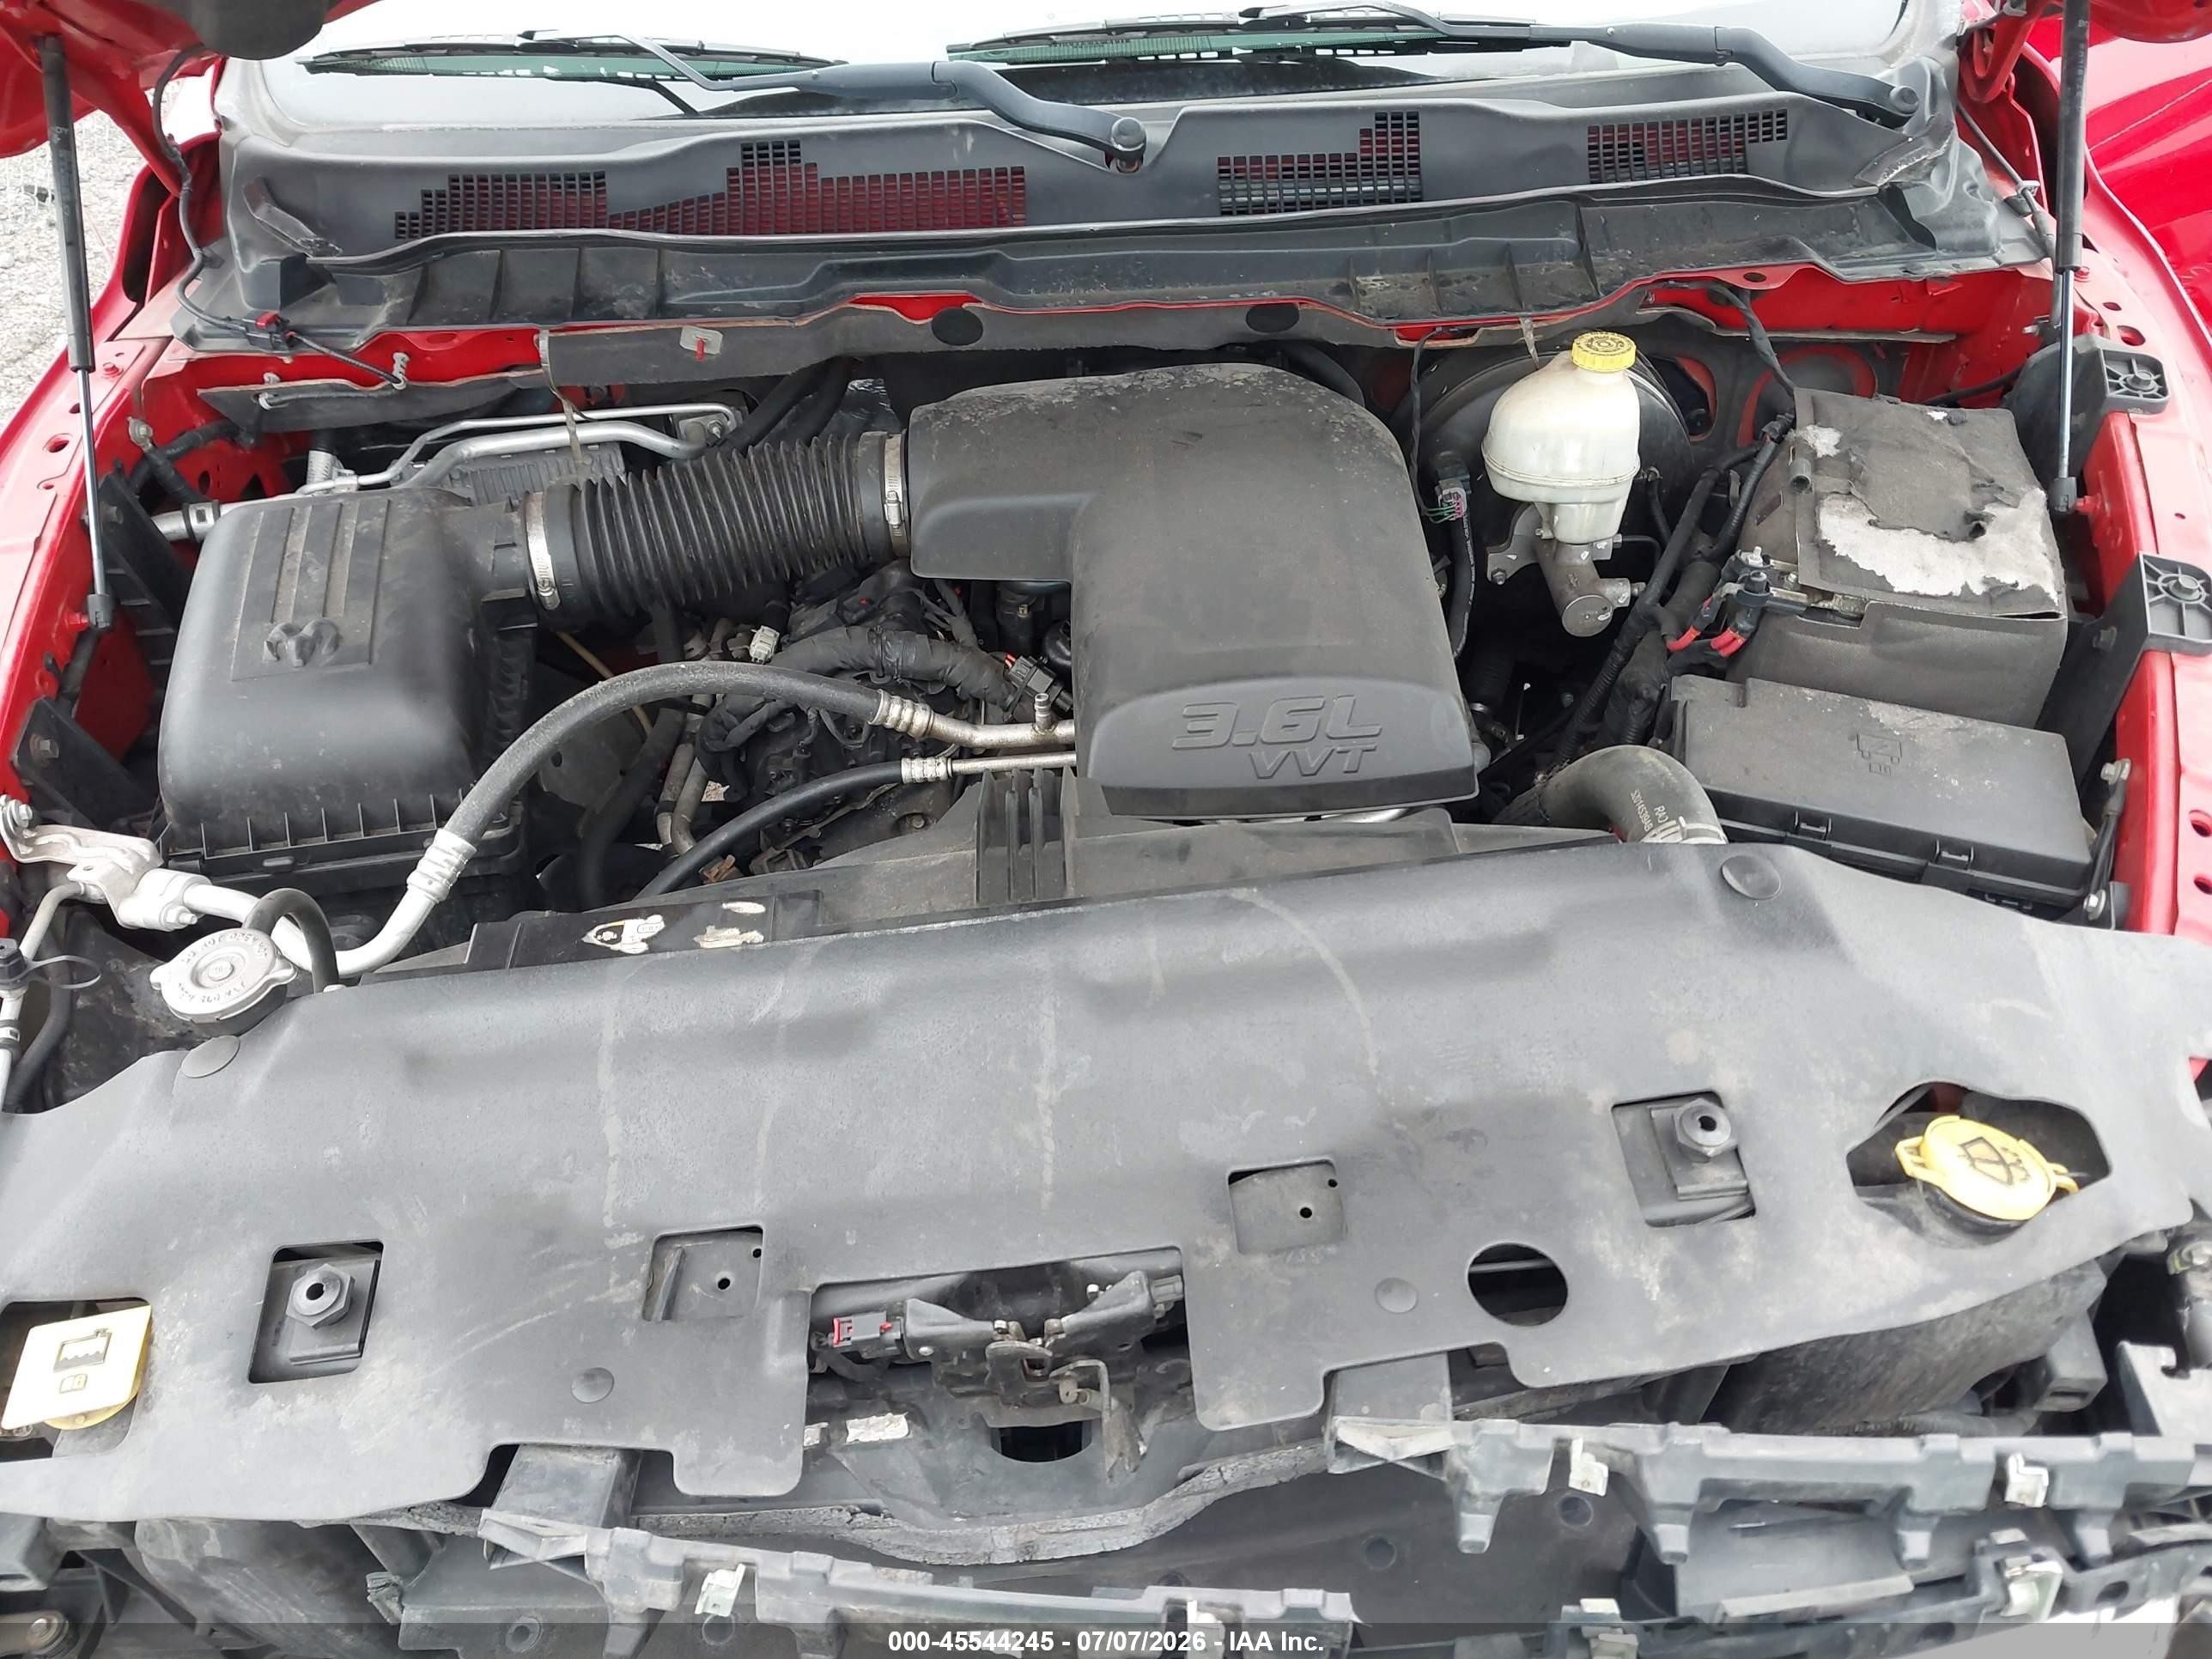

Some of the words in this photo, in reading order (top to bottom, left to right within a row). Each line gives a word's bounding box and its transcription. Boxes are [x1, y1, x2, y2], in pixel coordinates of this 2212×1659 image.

[1171, 695, 1382, 750] 3.6L
[1249, 744, 1377, 779] VVT
[1654, 805, 1669, 823] RAD
